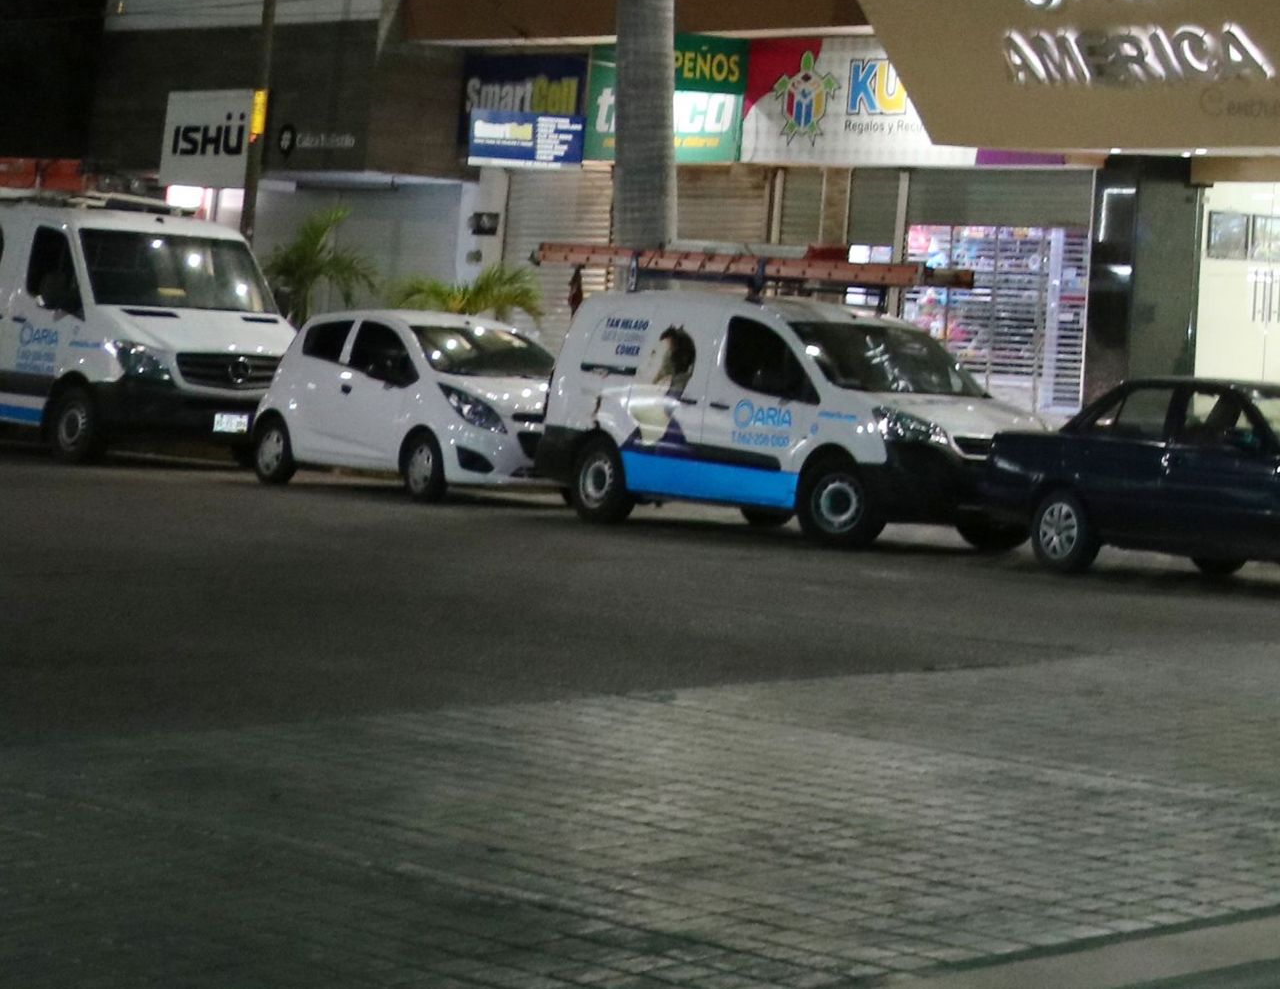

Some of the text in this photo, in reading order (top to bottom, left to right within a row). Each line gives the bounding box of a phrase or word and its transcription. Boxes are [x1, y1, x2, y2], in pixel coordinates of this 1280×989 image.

[1003, 22, 1276, 86] AMERICA
[171, 112, 246, 156] ISHÜ
[844, 119, 885, 134] Regalos
